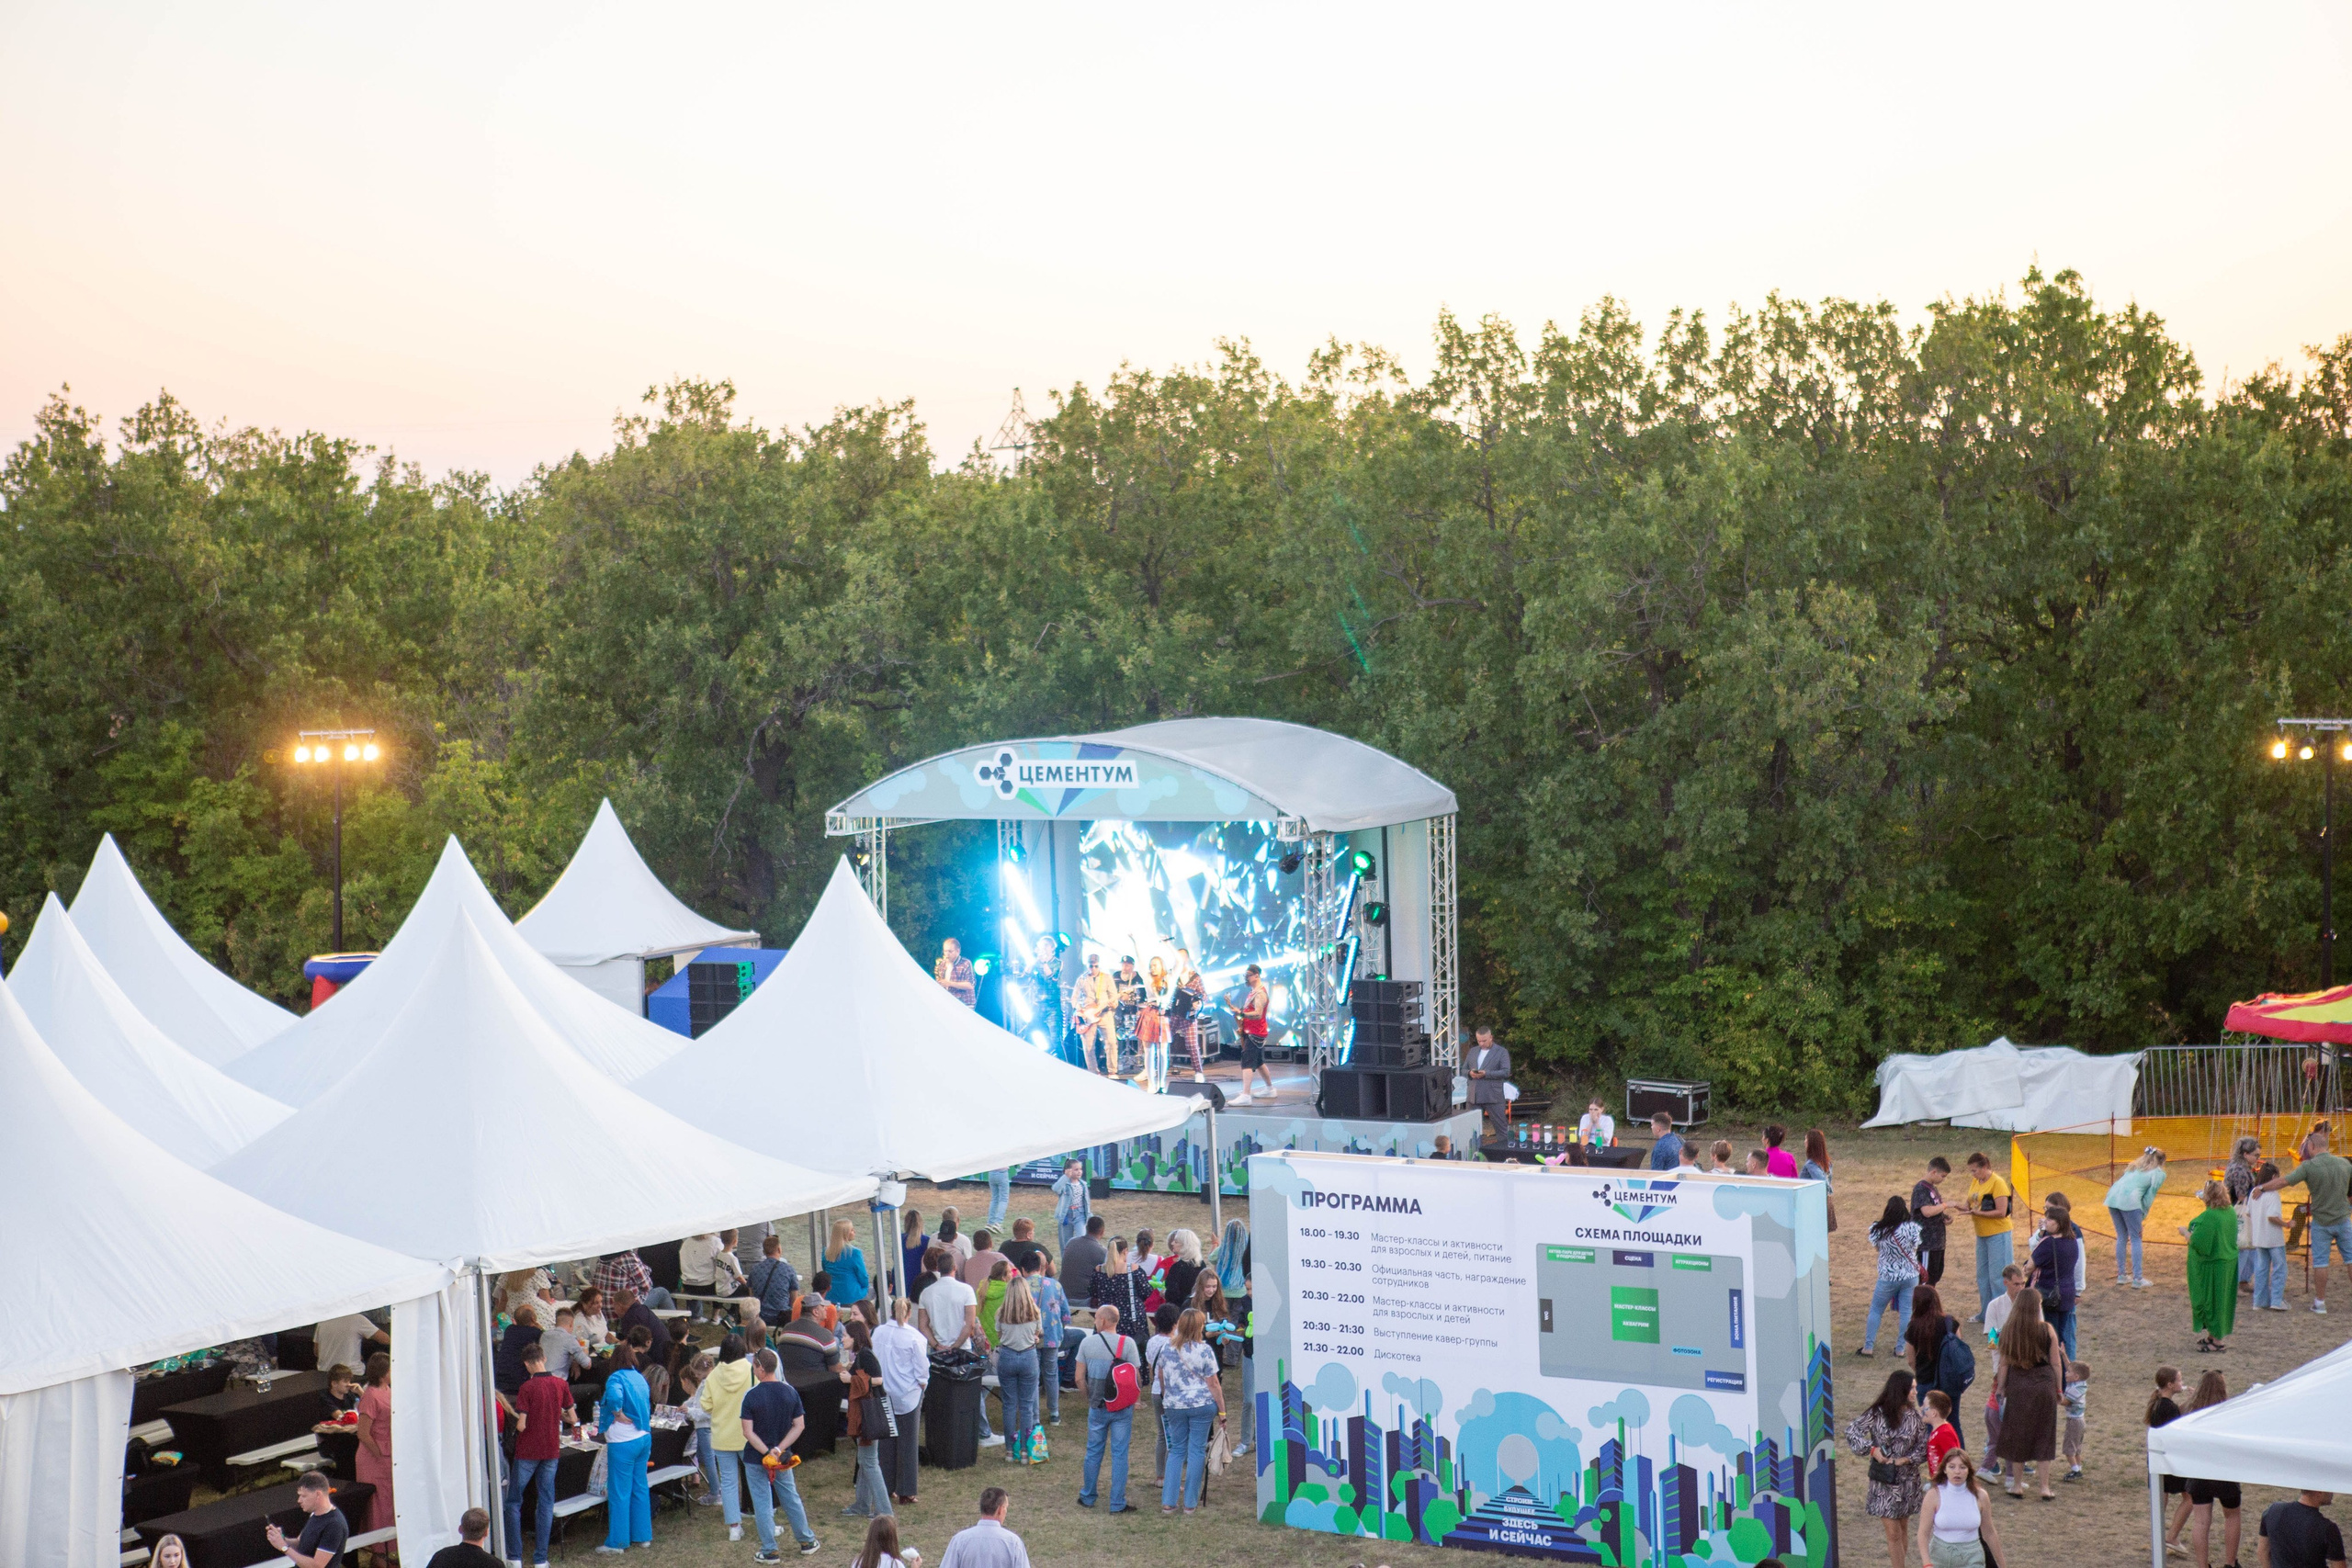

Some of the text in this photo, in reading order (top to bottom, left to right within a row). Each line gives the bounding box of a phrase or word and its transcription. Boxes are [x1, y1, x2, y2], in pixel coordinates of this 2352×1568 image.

[1019, 765, 1133, 785] ЦЕМЕНТУМ
[1301, 1190, 1422, 1214] ПРОГРАММА
[1614, 1191, 1677, 1204] ЦЕМЕНТУМ
[1300, 1227, 1326, 1238] 18.00
[1334, 1230, 1360, 1241] 19.30
[1575, 1227, 1702, 1247] СХЕМА ПЛОЩАДКИ
[1371, 1233, 1503, 1251] Мастер-классы и активности
[1371, 1246, 1512, 1264] для взрослых и детей, питание
[1301, 1258, 1326, 1269] 19.30
[1334, 1261, 1362, 1272] 20.30
[1372, 1264, 1527, 1286] Официальная часть, награждение
[1372, 1277, 1430, 1289] сотрудников
[1302, 1290, 1329, 1301] 20.30
[1337, 1292, 1365, 1303] 22.00
[1373, 1296, 1505, 1316] Мастер-классы и активности
[1613, 1303, 1657, 1313] МАСТЕР-КЛАССЫ
[1373, 1309, 1471, 1325] для взрослых и детей
[1623, 1320, 1650, 1328] АКВАГРИМ
[1303, 1320, 1330, 1332] 20:30
[1339, 1324, 1364, 1335] 21:30
[1374, 1327, 1498, 1348] Выступление кавер-группы
[1303, 1342, 1329, 1353] 21.30
[1337, 1345, 1364, 1356] 22.00
[1374, 1348, 1421, 1362] Дискотека
[1672, 1348, 1702, 1356] ФОТОЗОНА
[1707, 1377, 1744, 1386] РЕГИСТРАЦИЯ
[1506, 1496, 1533, 1505] СТРОИМ
[1503, 1506, 1535, 1516] БУДУЩЕЕ
[1502, 1517, 1539, 1530] ЗДЕСЬ
[1488, 1529, 1553, 1547] И СЕЙЧАС
